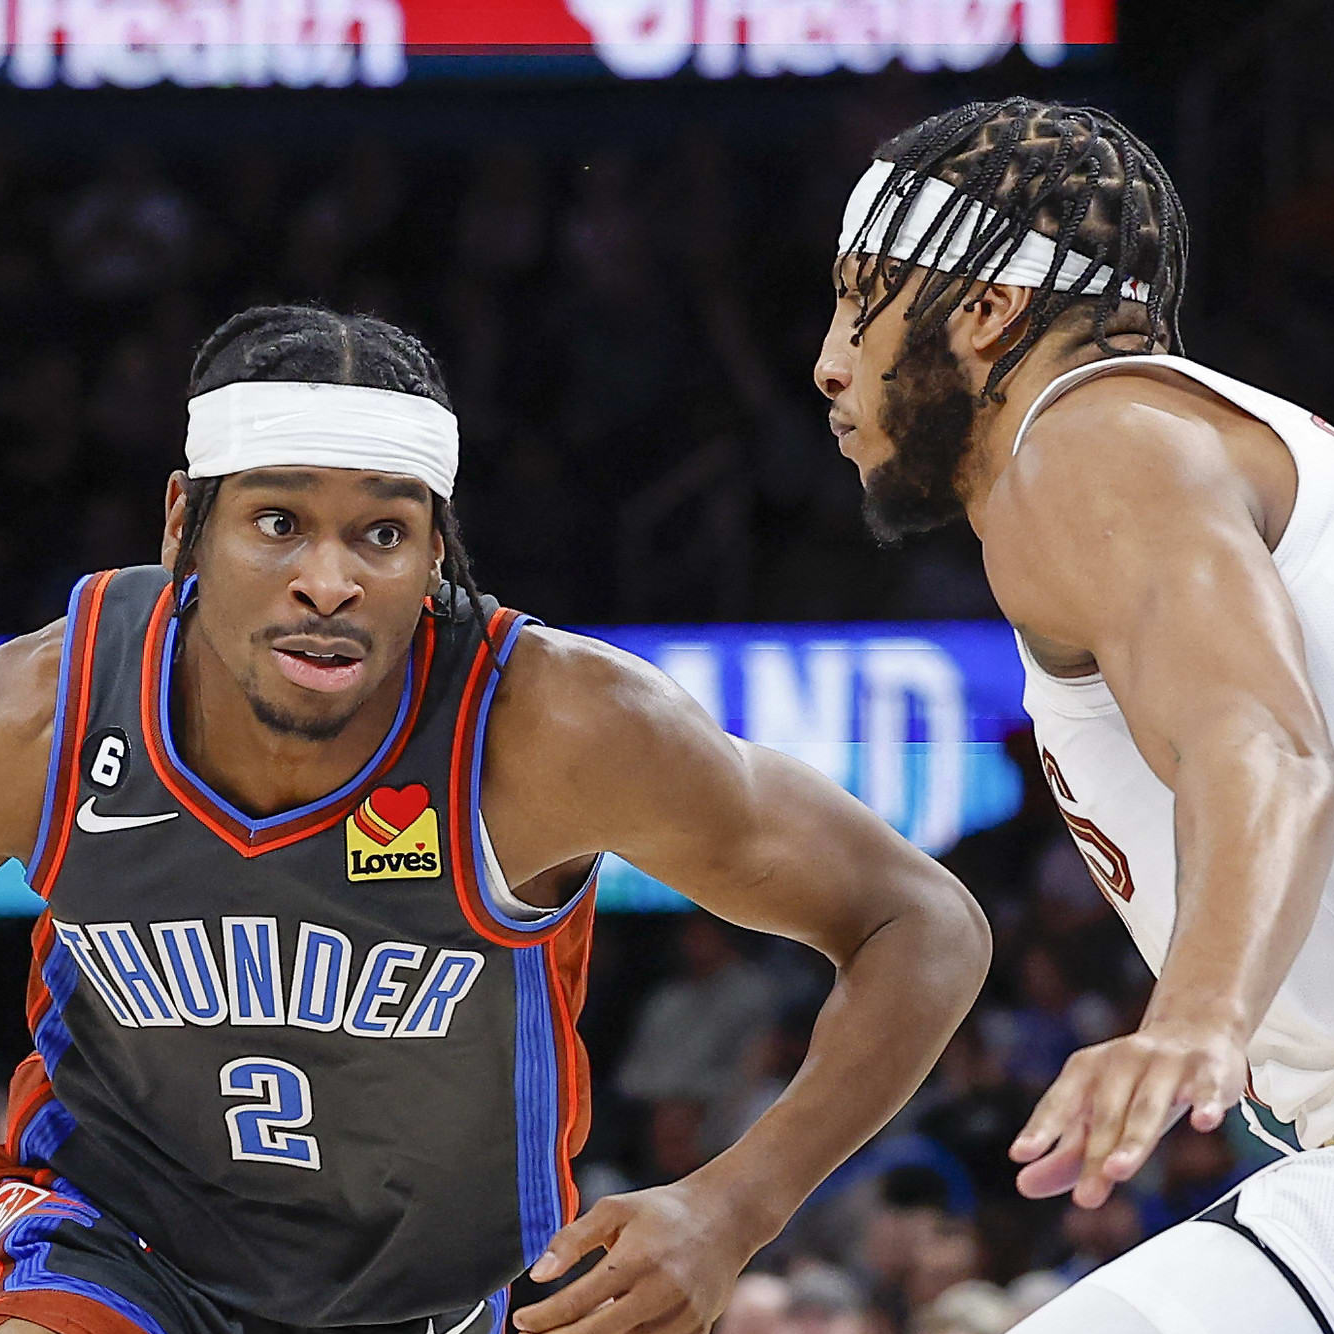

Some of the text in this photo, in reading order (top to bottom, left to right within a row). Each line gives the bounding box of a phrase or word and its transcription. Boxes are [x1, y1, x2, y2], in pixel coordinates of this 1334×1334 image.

[90, 735, 125, 787] 6
[52, 917, 485, 1039] THUNDER
[220, 1056, 321, 1170] 2
